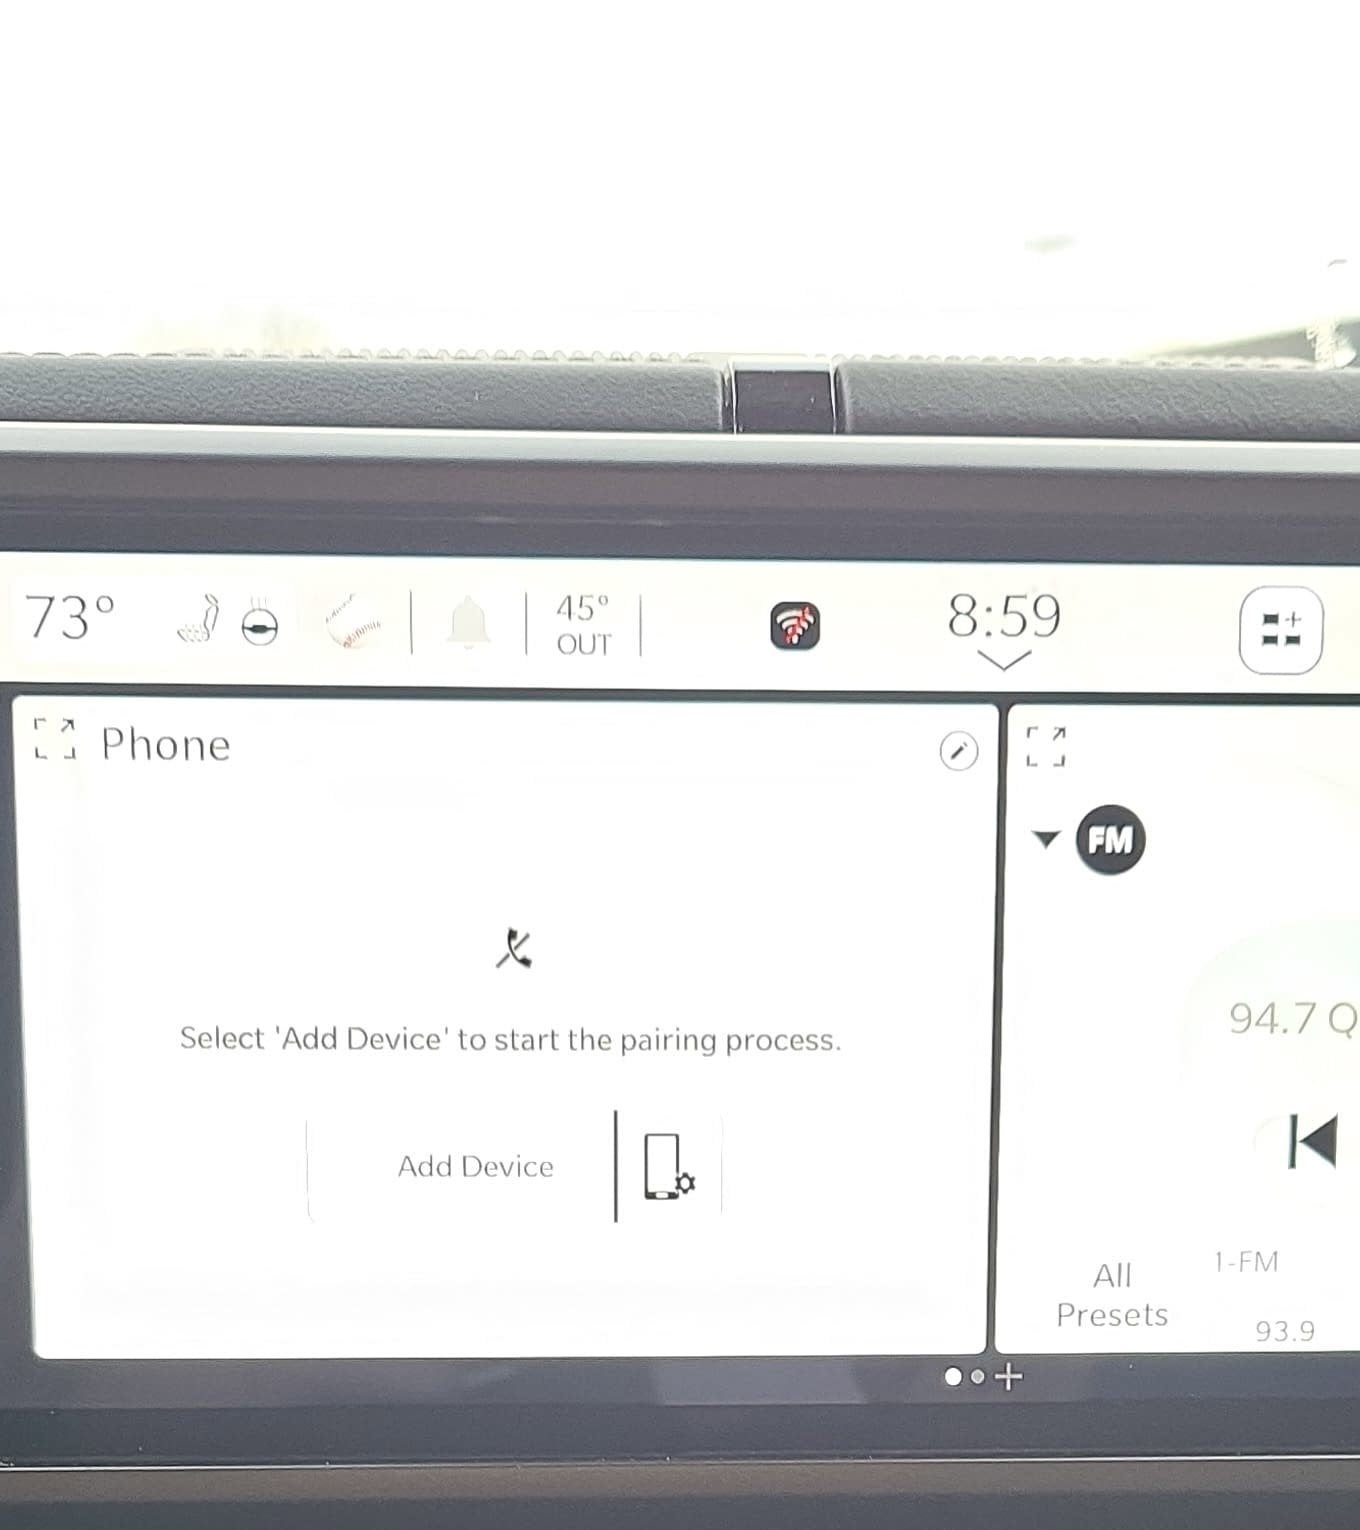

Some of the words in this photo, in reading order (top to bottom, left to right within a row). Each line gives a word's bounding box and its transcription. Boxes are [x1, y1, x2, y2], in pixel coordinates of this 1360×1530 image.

[25, 595, 115, 641] 73°
[556, 593, 610, 622] 45°
[948, 593, 1061, 638] 8:59
[557, 633, 612, 656] OUT
[102, 726, 231, 762] Phone
[1088, 825, 1133, 854] FM
[1229, 1001, 1316, 1036] 94.7
[181, 1025, 264, 1051] Select
[275, 1025, 338, 1051] 'Add
[347, 1026, 449, 1051] Device'
[457, 1029, 487, 1051] to
[495, 1029, 559, 1052] start
[567, 1026, 613, 1052] the
[619, 1026, 717, 1058] pairing
[725, 1032, 842, 1057] process.
[397, 1155, 452, 1179] Add
[462, 1155, 554, 1179] Device
[1093, 1261, 1131, 1289] All
[1215, 1250, 1279, 1273] 1-FM
[1056, 1301, 1169, 1330] Presets
[1256, 1319, 1314, 1343] 93.9
